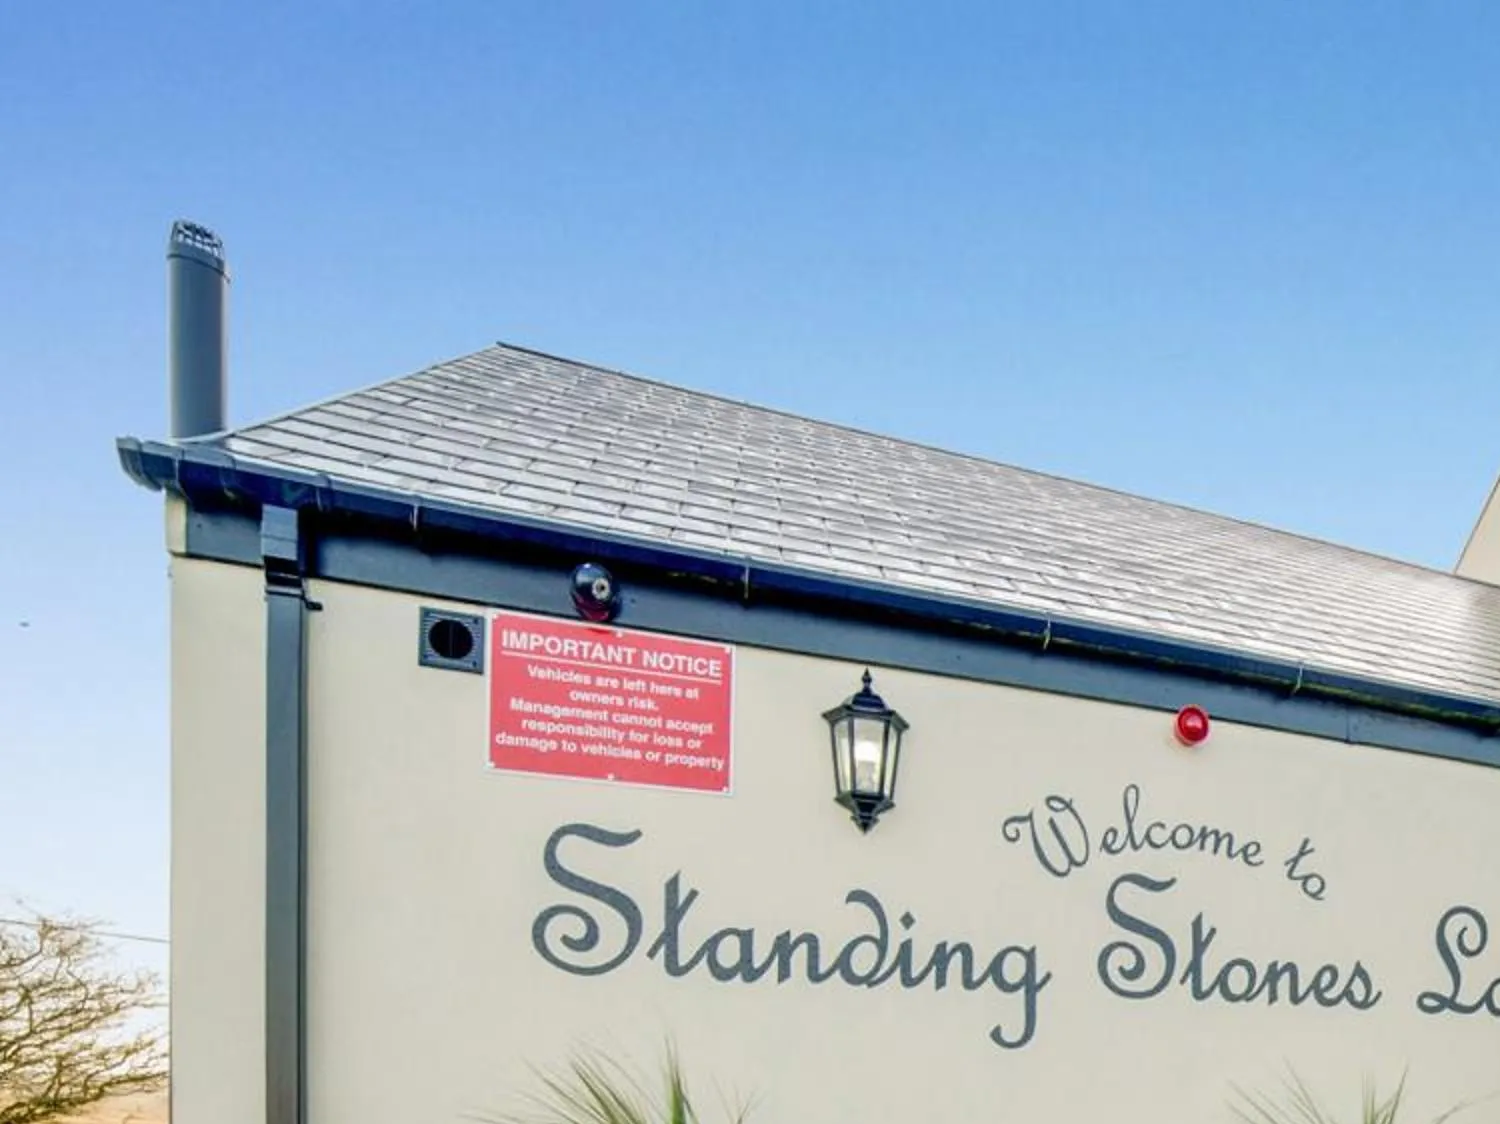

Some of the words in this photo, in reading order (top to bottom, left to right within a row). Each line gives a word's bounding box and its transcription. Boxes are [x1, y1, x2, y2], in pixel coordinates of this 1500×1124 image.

[502, 629, 636, 664] IMPORTANT
[642, 650, 722, 678] NOTICE
[528, 664, 592, 685] Vehicles
[595, 677, 620, 688] are
[623, 678, 647, 693] left
[649, 681, 682, 698] here
[685, 688, 699, 700] at
[569, 690, 625, 706] owners
[628, 696, 659, 711] risk.
[510, 697, 609, 721] Management
[612, 711, 663, 728] cannot
[665, 719, 713, 736] accept
[521, 718, 625, 744] responsibility
[629, 729, 650, 742] for
[653, 732, 683, 748] loss
[687, 739, 702, 749] or
[496, 732, 557, 752] damage
[562, 739, 577, 753] to
[581, 743, 642, 760] vehicles
[645, 751, 661, 762] or
[664, 753, 724, 772] property
[1002, 783, 1264, 878] Welcome
[1284, 837, 1326, 901] to
[531, 823, 1052, 1050] Standing
[1097, 873, 1383, 1011] Stones
